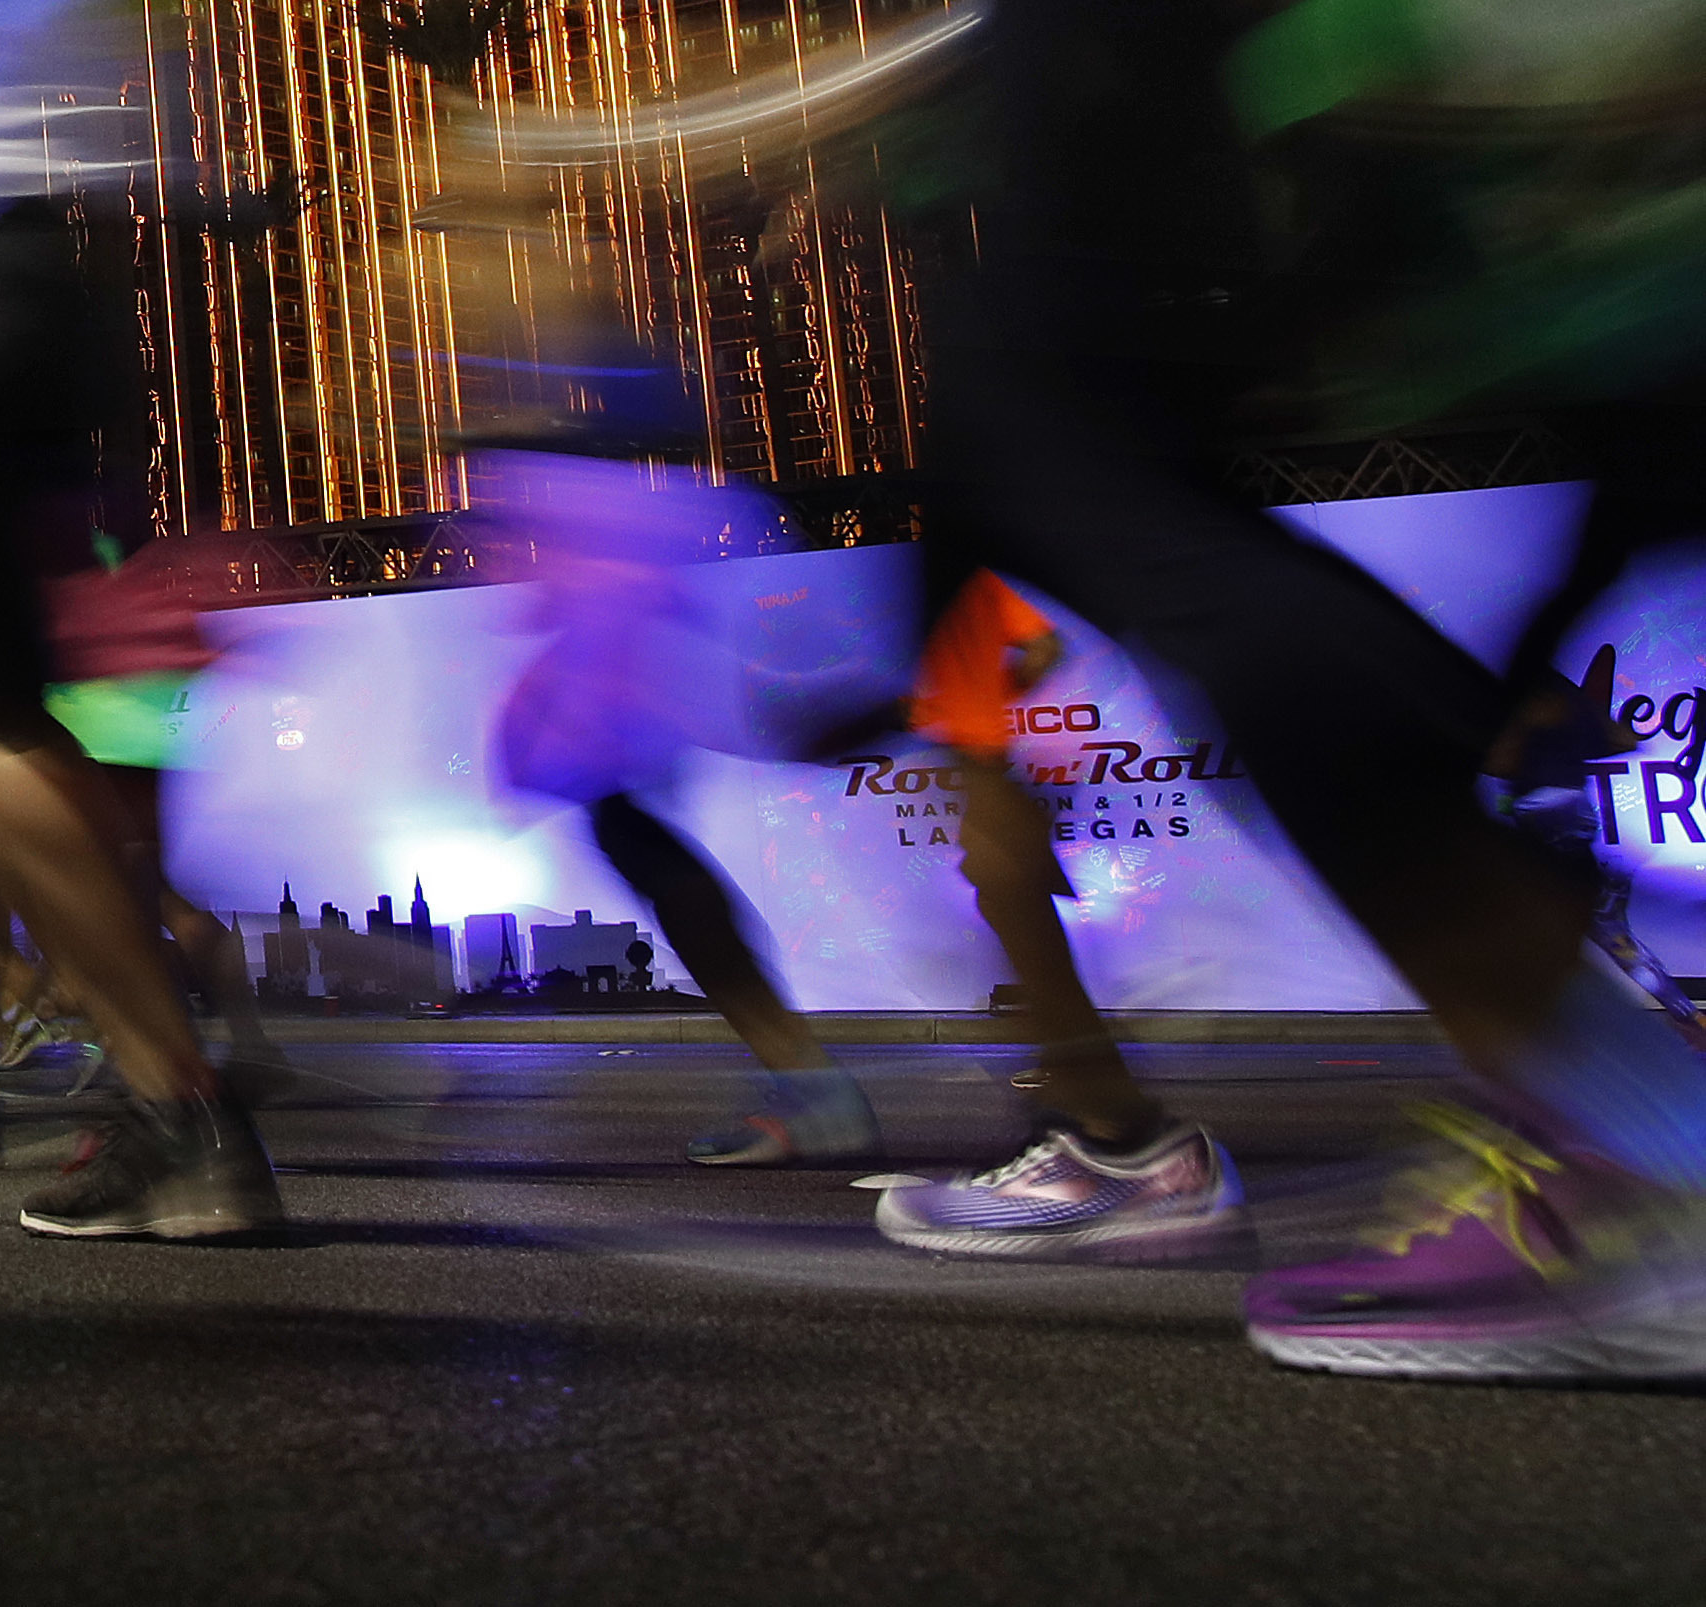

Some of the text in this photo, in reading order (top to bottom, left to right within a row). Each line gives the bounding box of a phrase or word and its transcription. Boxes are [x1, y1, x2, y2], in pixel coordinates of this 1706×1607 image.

[1005, 703, 1101, 735] EICO
[838, 754, 1015, 797] Roc
[1079, 740, 1245, 785] Roll
[895, 796, 1073, 818] MARON
[1094, 795, 1110, 810] &
[898, 816, 1190, 847] LA EGAS
